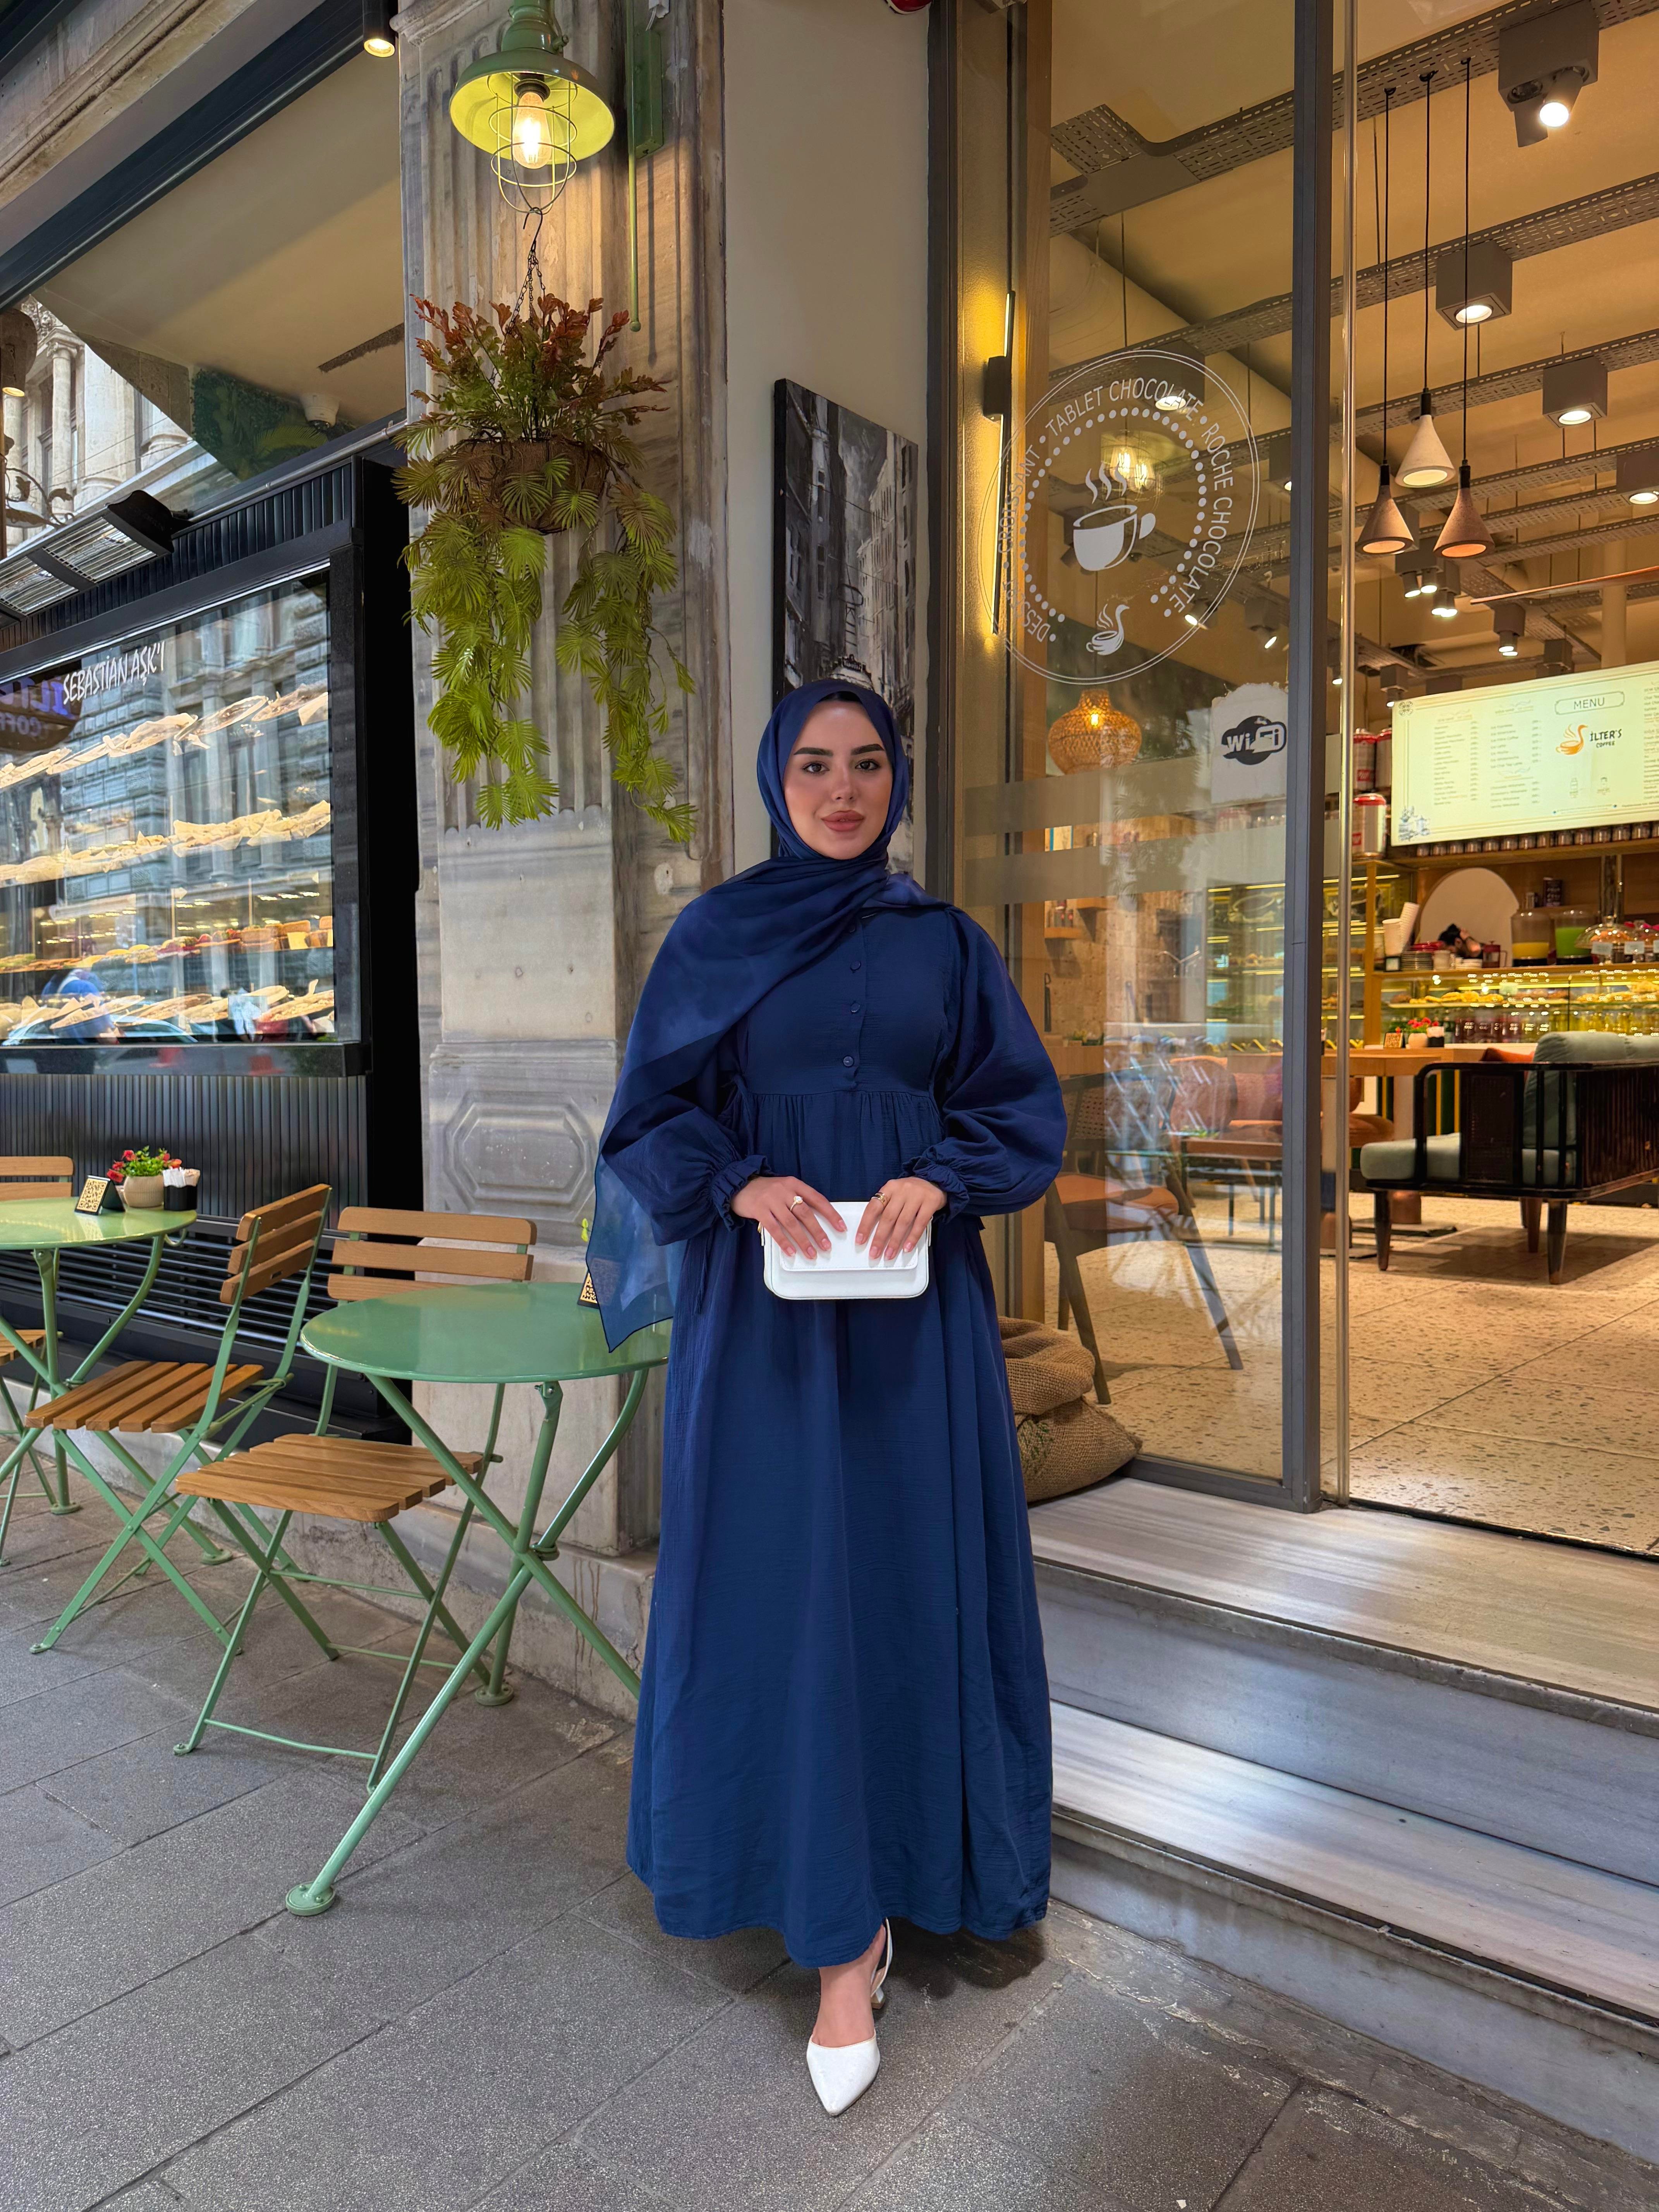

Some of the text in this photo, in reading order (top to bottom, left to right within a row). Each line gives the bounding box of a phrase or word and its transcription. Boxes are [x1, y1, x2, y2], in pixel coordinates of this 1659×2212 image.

[1045, 378, 1204, 436] TABLET CHOCOLATE
[998, 445, 1040, 553] CROISSANT
[1169, 422, 1233, 613] ROCHE CHOCOLATE
[1573, 697, 1605, 710] MENU
[1590, 728, 1622, 742] İLTER'S
